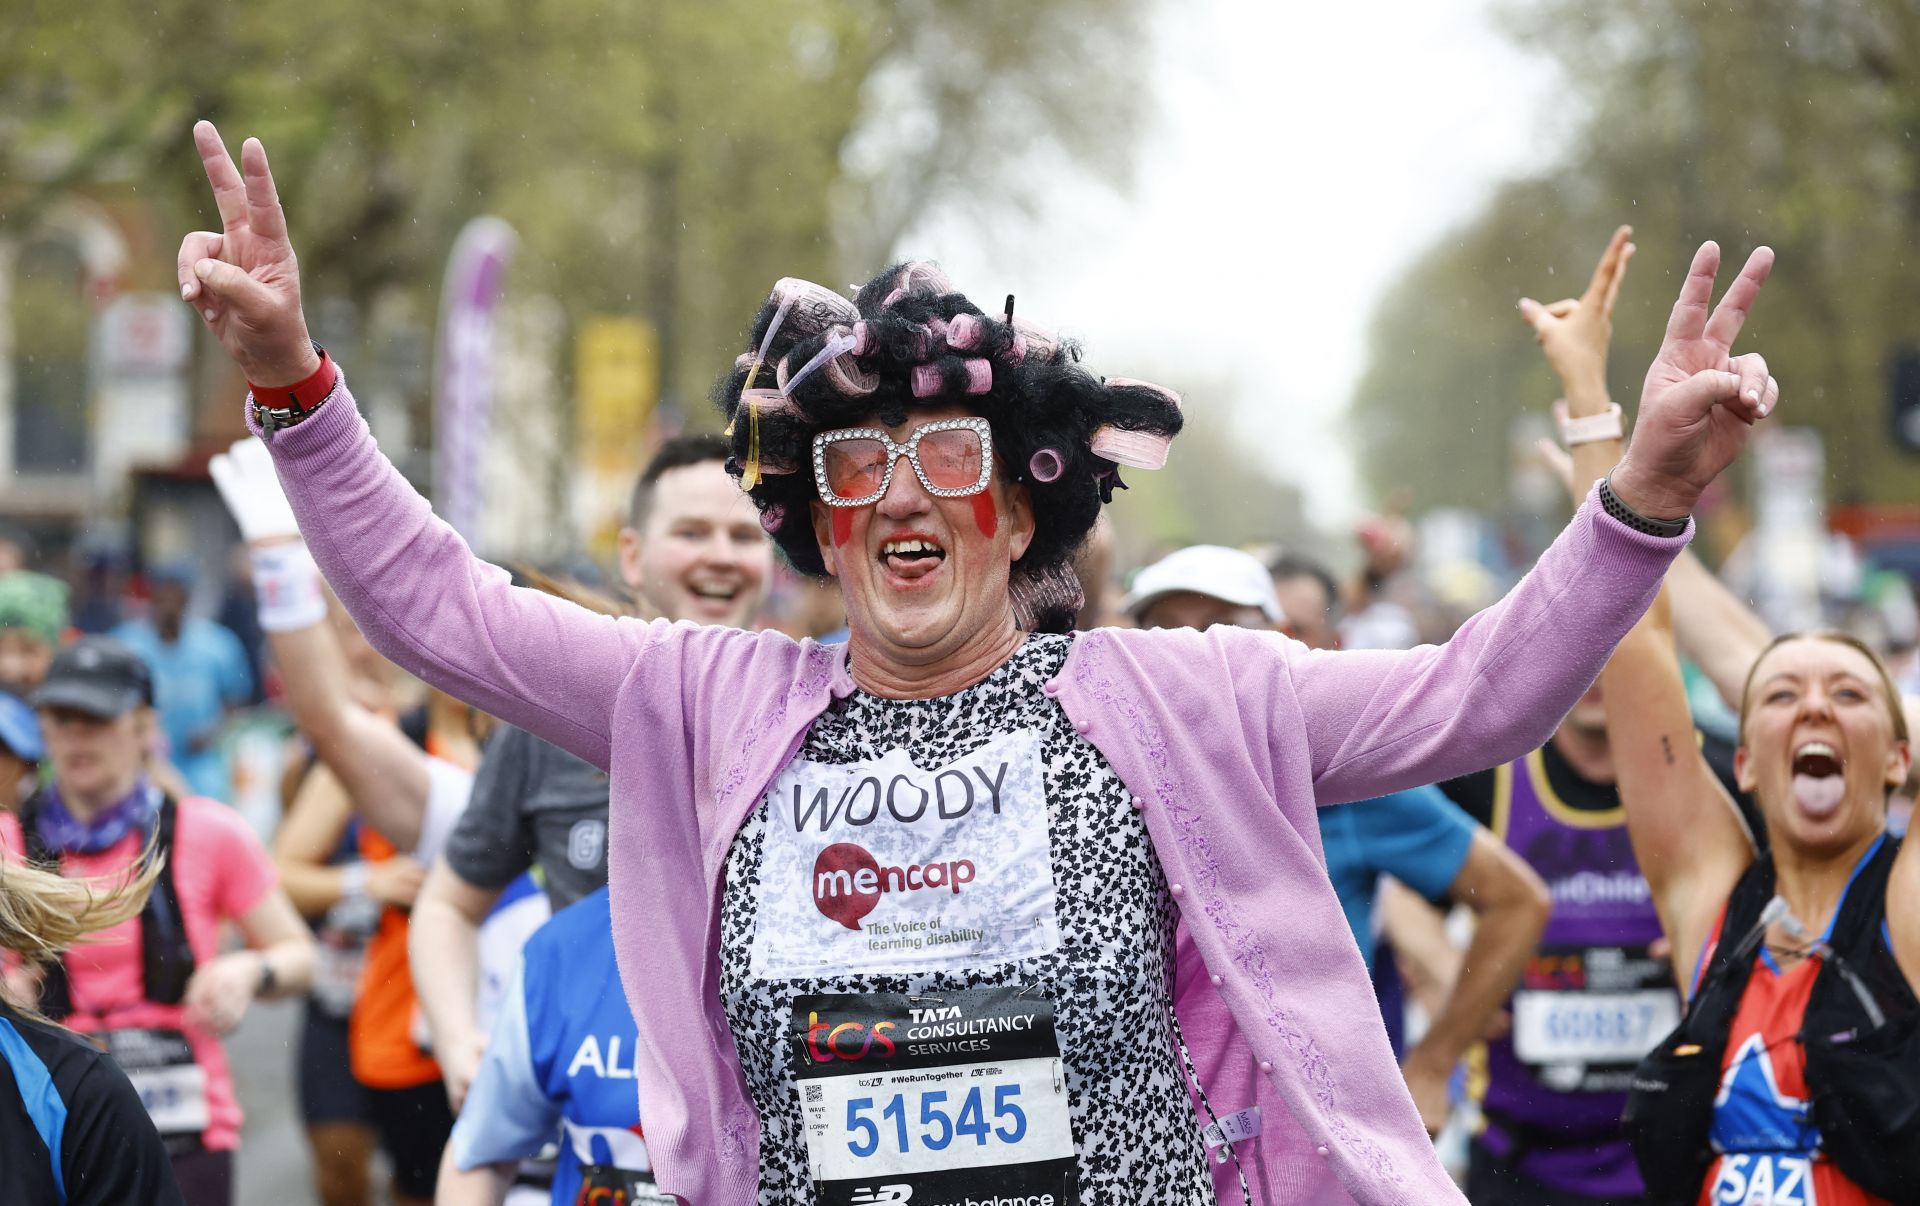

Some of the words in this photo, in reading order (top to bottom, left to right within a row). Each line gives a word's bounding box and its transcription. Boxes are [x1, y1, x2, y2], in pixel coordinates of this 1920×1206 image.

[793, 762, 1009, 833] WOODY
[817, 858, 976, 899] mencap
[866, 922, 890, 936] The
[893, 919, 927, 934] Voice
[929, 916, 942, 930] of
[868, 936, 922, 951] learning
[926, 928, 984, 944] disability
[907, 1014, 1035, 1041] CONSULTANCY
[908, 1005, 963, 1024] TATA
[808, 1011, 897, 1063] tcs
[907, 1039, 991, 1056] SERVICES
[891, 1071, 964, 1084] #WeRunTogether
[846, 1083, 1028, 1158] 51545
[1720, 1153, 1806, 1206] SAZ
